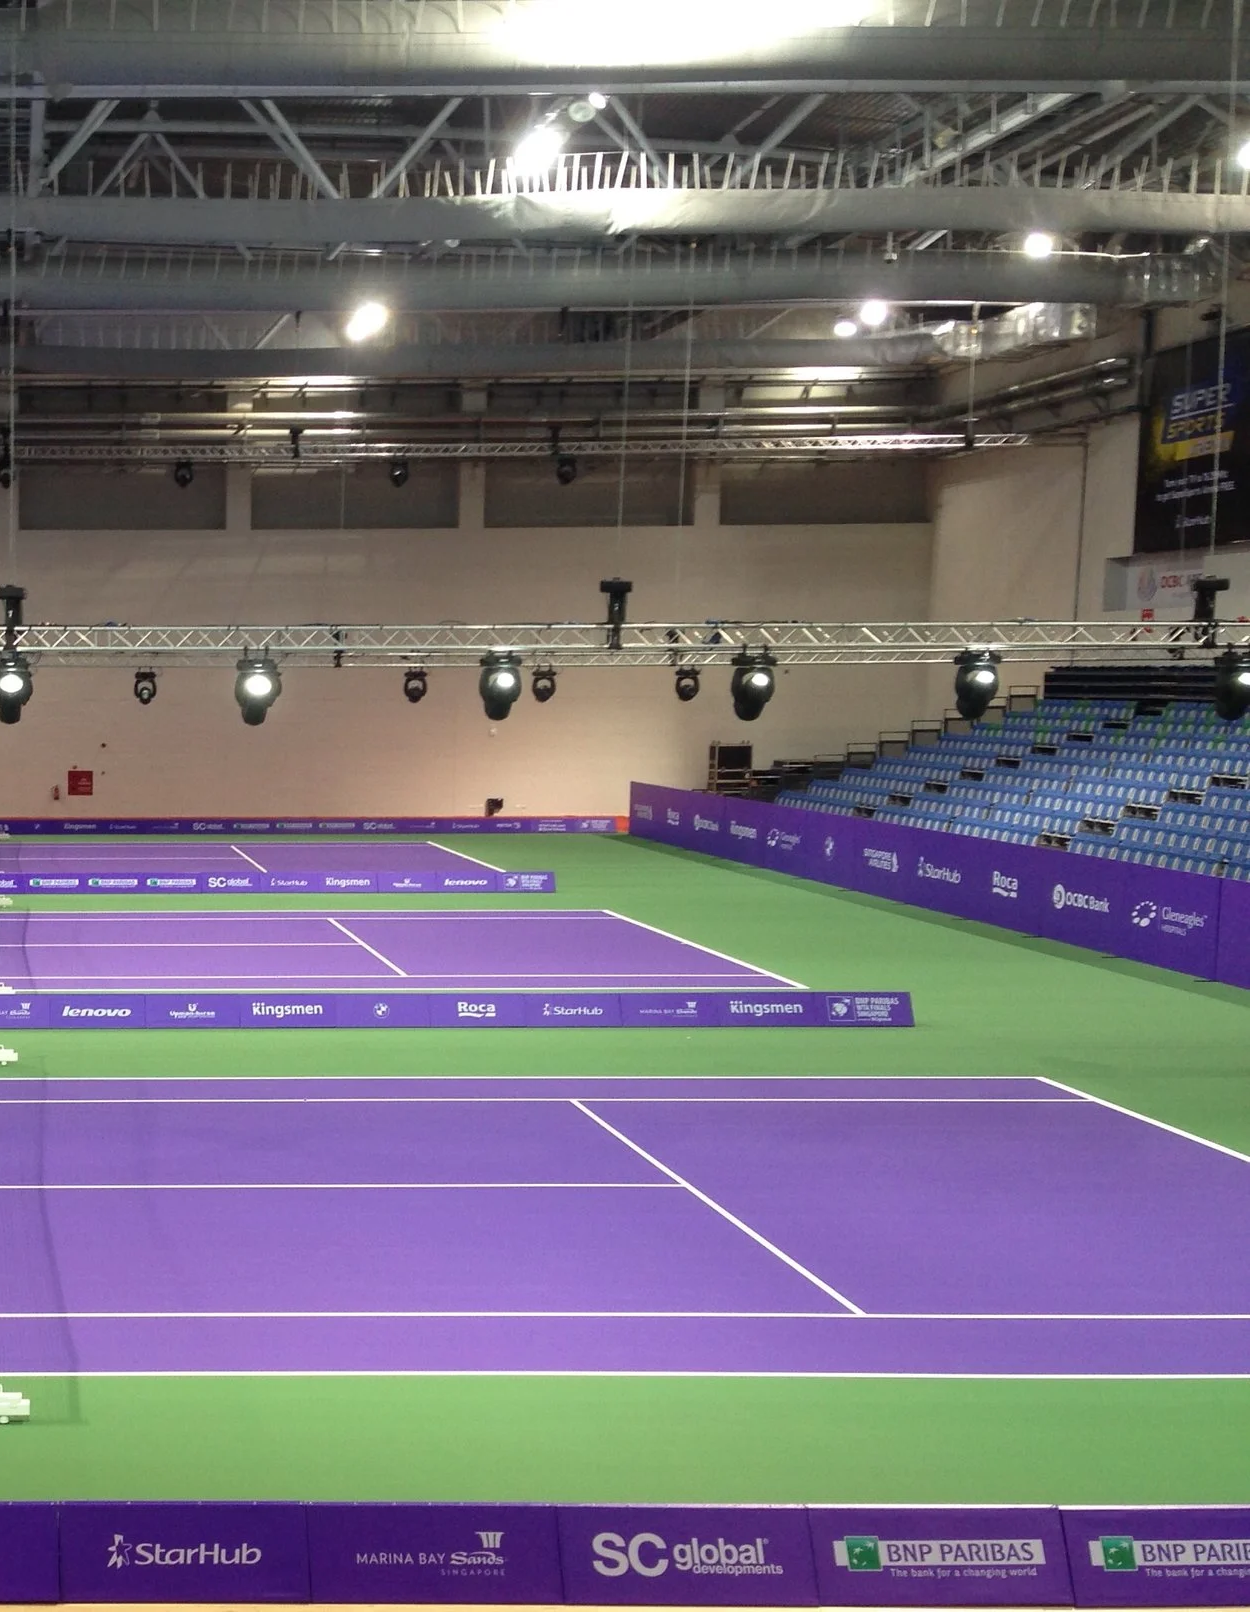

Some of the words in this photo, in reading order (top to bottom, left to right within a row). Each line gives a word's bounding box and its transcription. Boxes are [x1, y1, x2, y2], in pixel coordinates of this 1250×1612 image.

[925, 863, 961, 884] StarHub
[993, 871, 1018, 890] Roca
[208, 877, 226, 888] SC
[326, 877, 370, 888] Kingsmen
[1065, 892, 1088, 909] OCBC
[1089, 896, 1110, 913] Bank
[1162, 907, 1205, 929] Gleneagles
[62, 1006, 131, 1018] lenovo
[252, 1002, 323, 1018] Kingsmen
[457, 1002, 496, 1012] Roca
[554, 1006, 603, 1015] StarHub
[730, 1000, 803, 1016] Kingsmen
[134, 1543, 263, 1567] StarHub
[356, 1552, 412, 1566] MARINA
[413, 1553, 447, 1565] BAY
[450, 1549, 506, 1565] Sands
[592, 1532, 667, 1577] SC
[674, 1538, 764, 1574] global
[886, 1542, 933, 1562] BNP
[940, 1542, 1035, 1562] PARIBAS
[1141, 1543, 1186, 1562] BNP
[692, 1562, 784, 1577] developments
[890, 1568, 910, 1577] The
[913, 1568, 935, 1577] bank
[937, 1568, 952, 1579] for
[963, 1568, 1008, 1579] changing
[1010, 1567, 1037, 1577] world
[1146, 1568, 1163, 1577] The
[1165, 1568, 1188, 1577] bank
[1190, 1568, 1205, 1578] for
